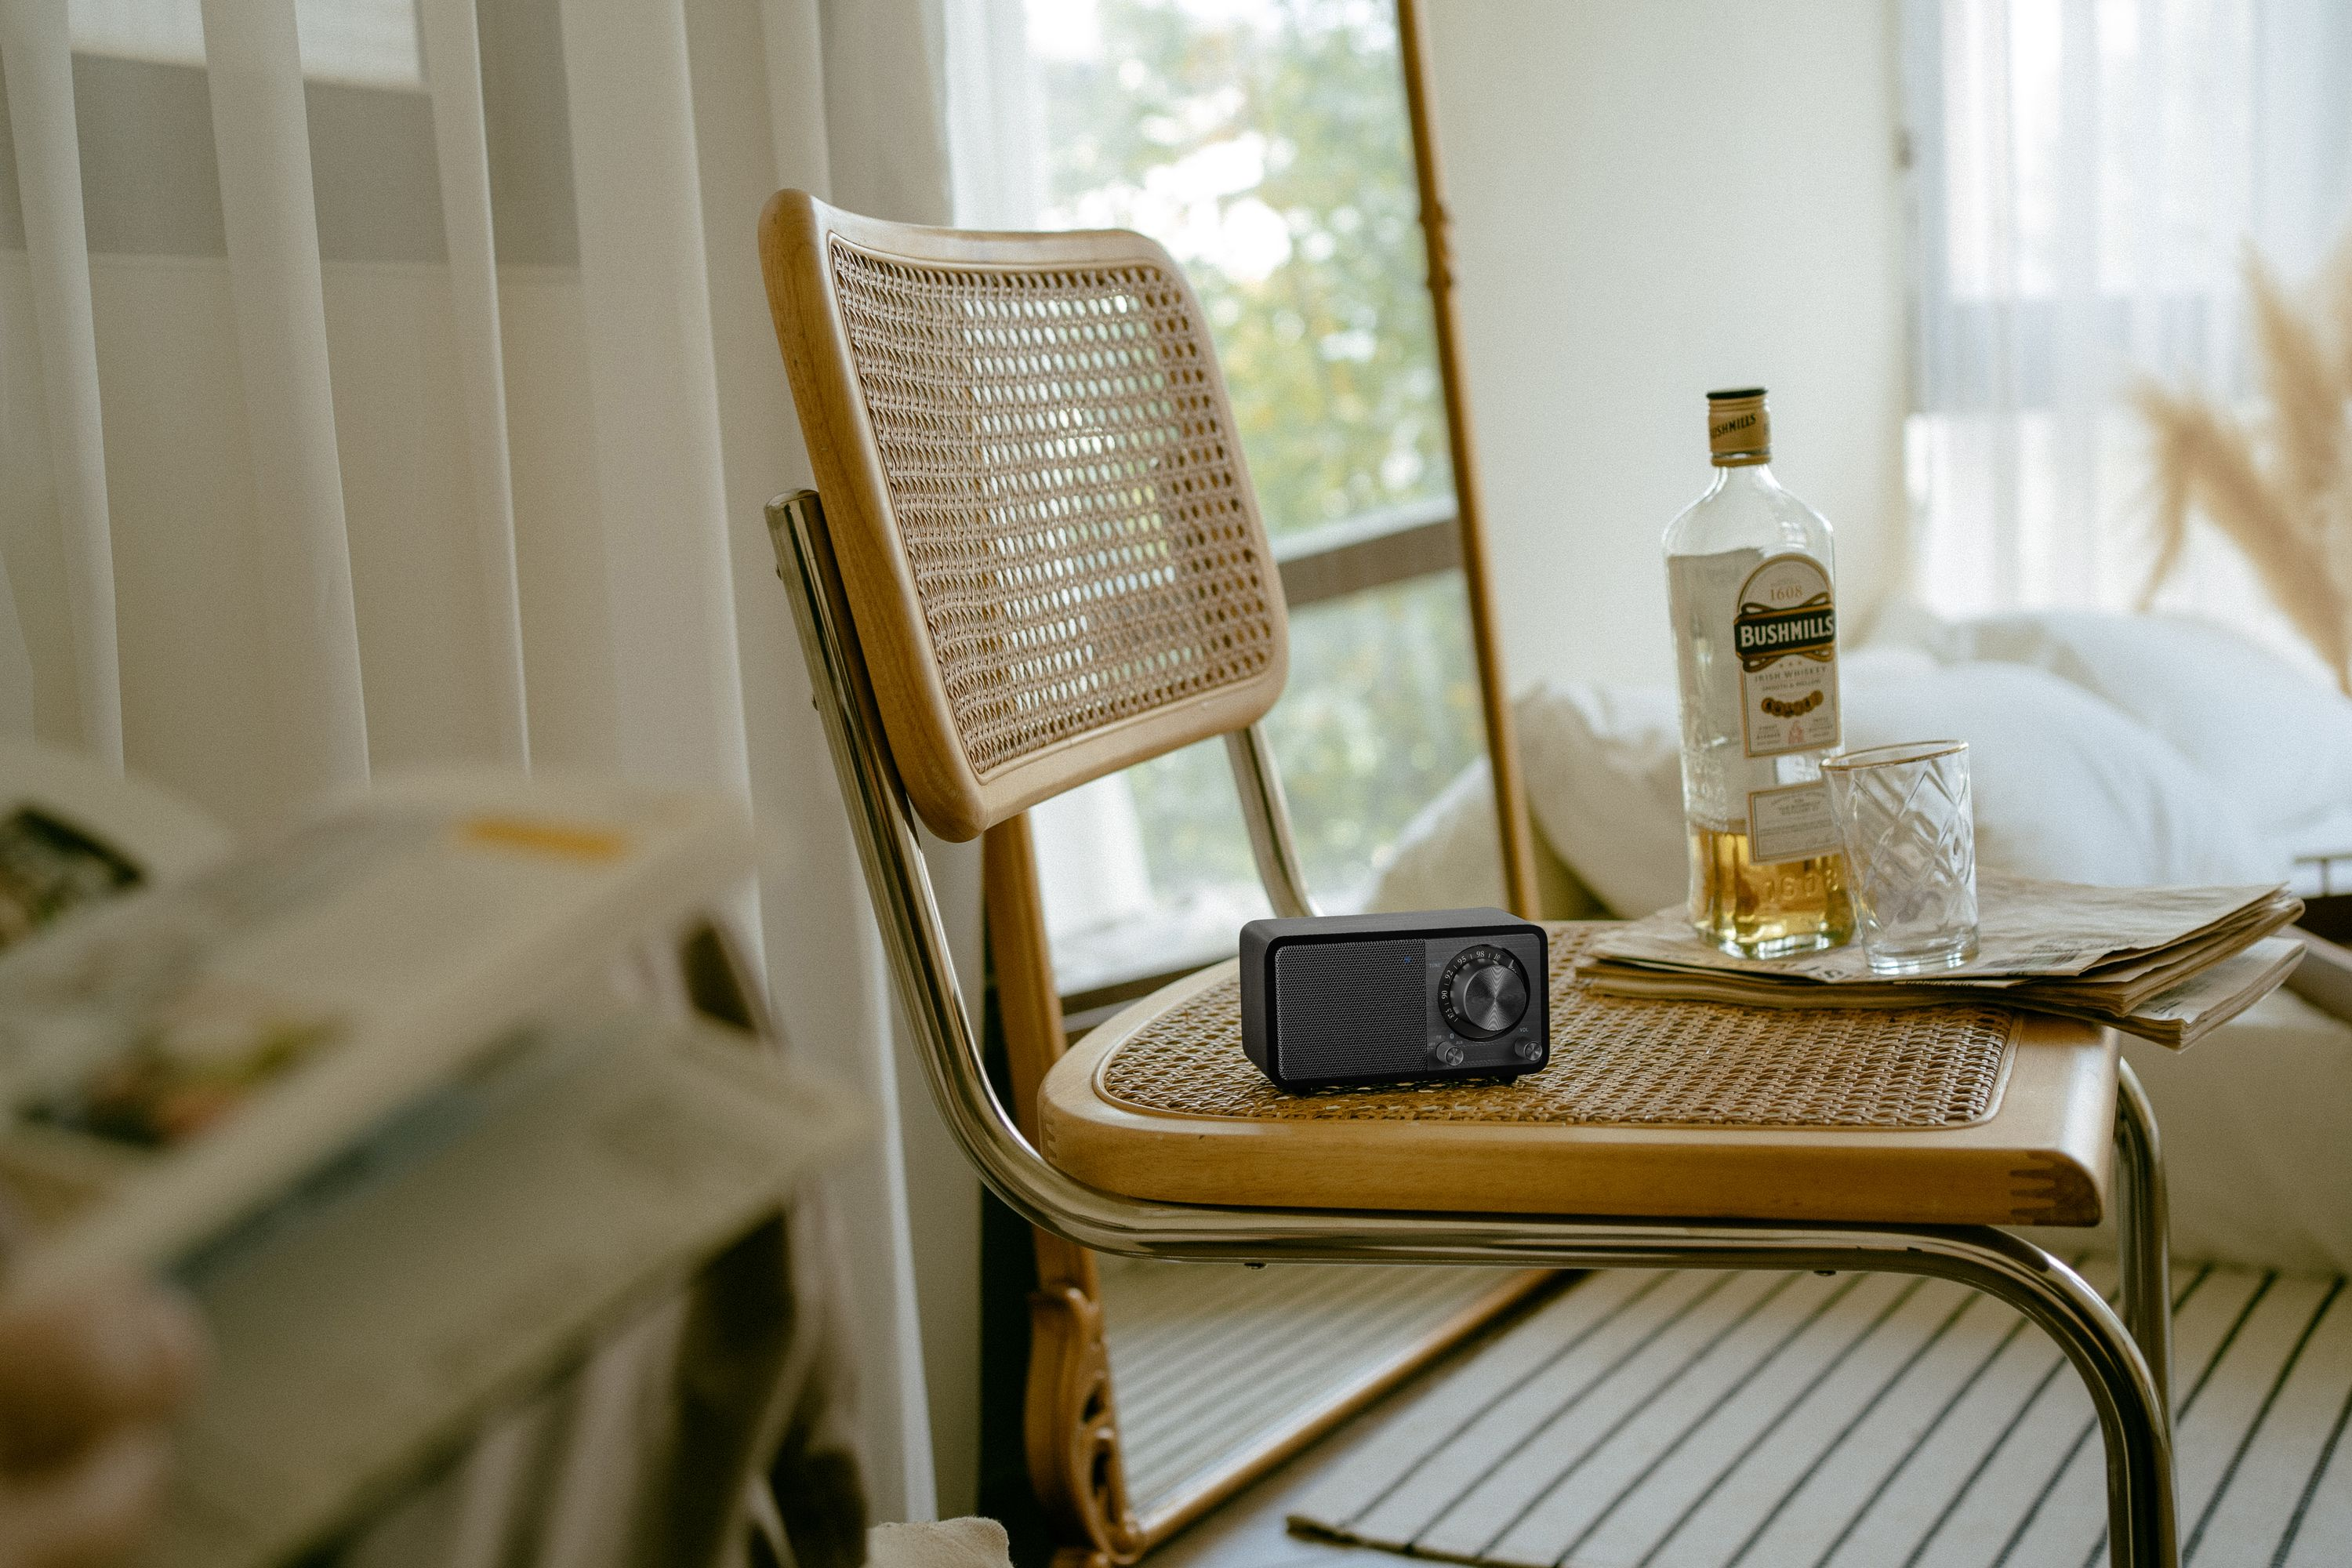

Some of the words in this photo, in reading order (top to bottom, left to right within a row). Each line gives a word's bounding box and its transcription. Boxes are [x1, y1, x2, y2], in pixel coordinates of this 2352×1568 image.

[1770, 585, 1803, 601] 1608
[1740, 615, 1834, 648] BUSHMILLS
[1755, 673, 1780, 682] IRISH
[1784, 666, 1827, 678] WHISKEY
[1457, 955, 1467, 965] 95
[1444, 969, 1454, 979] 92
[1441, 990, 1448, 1000] 90
